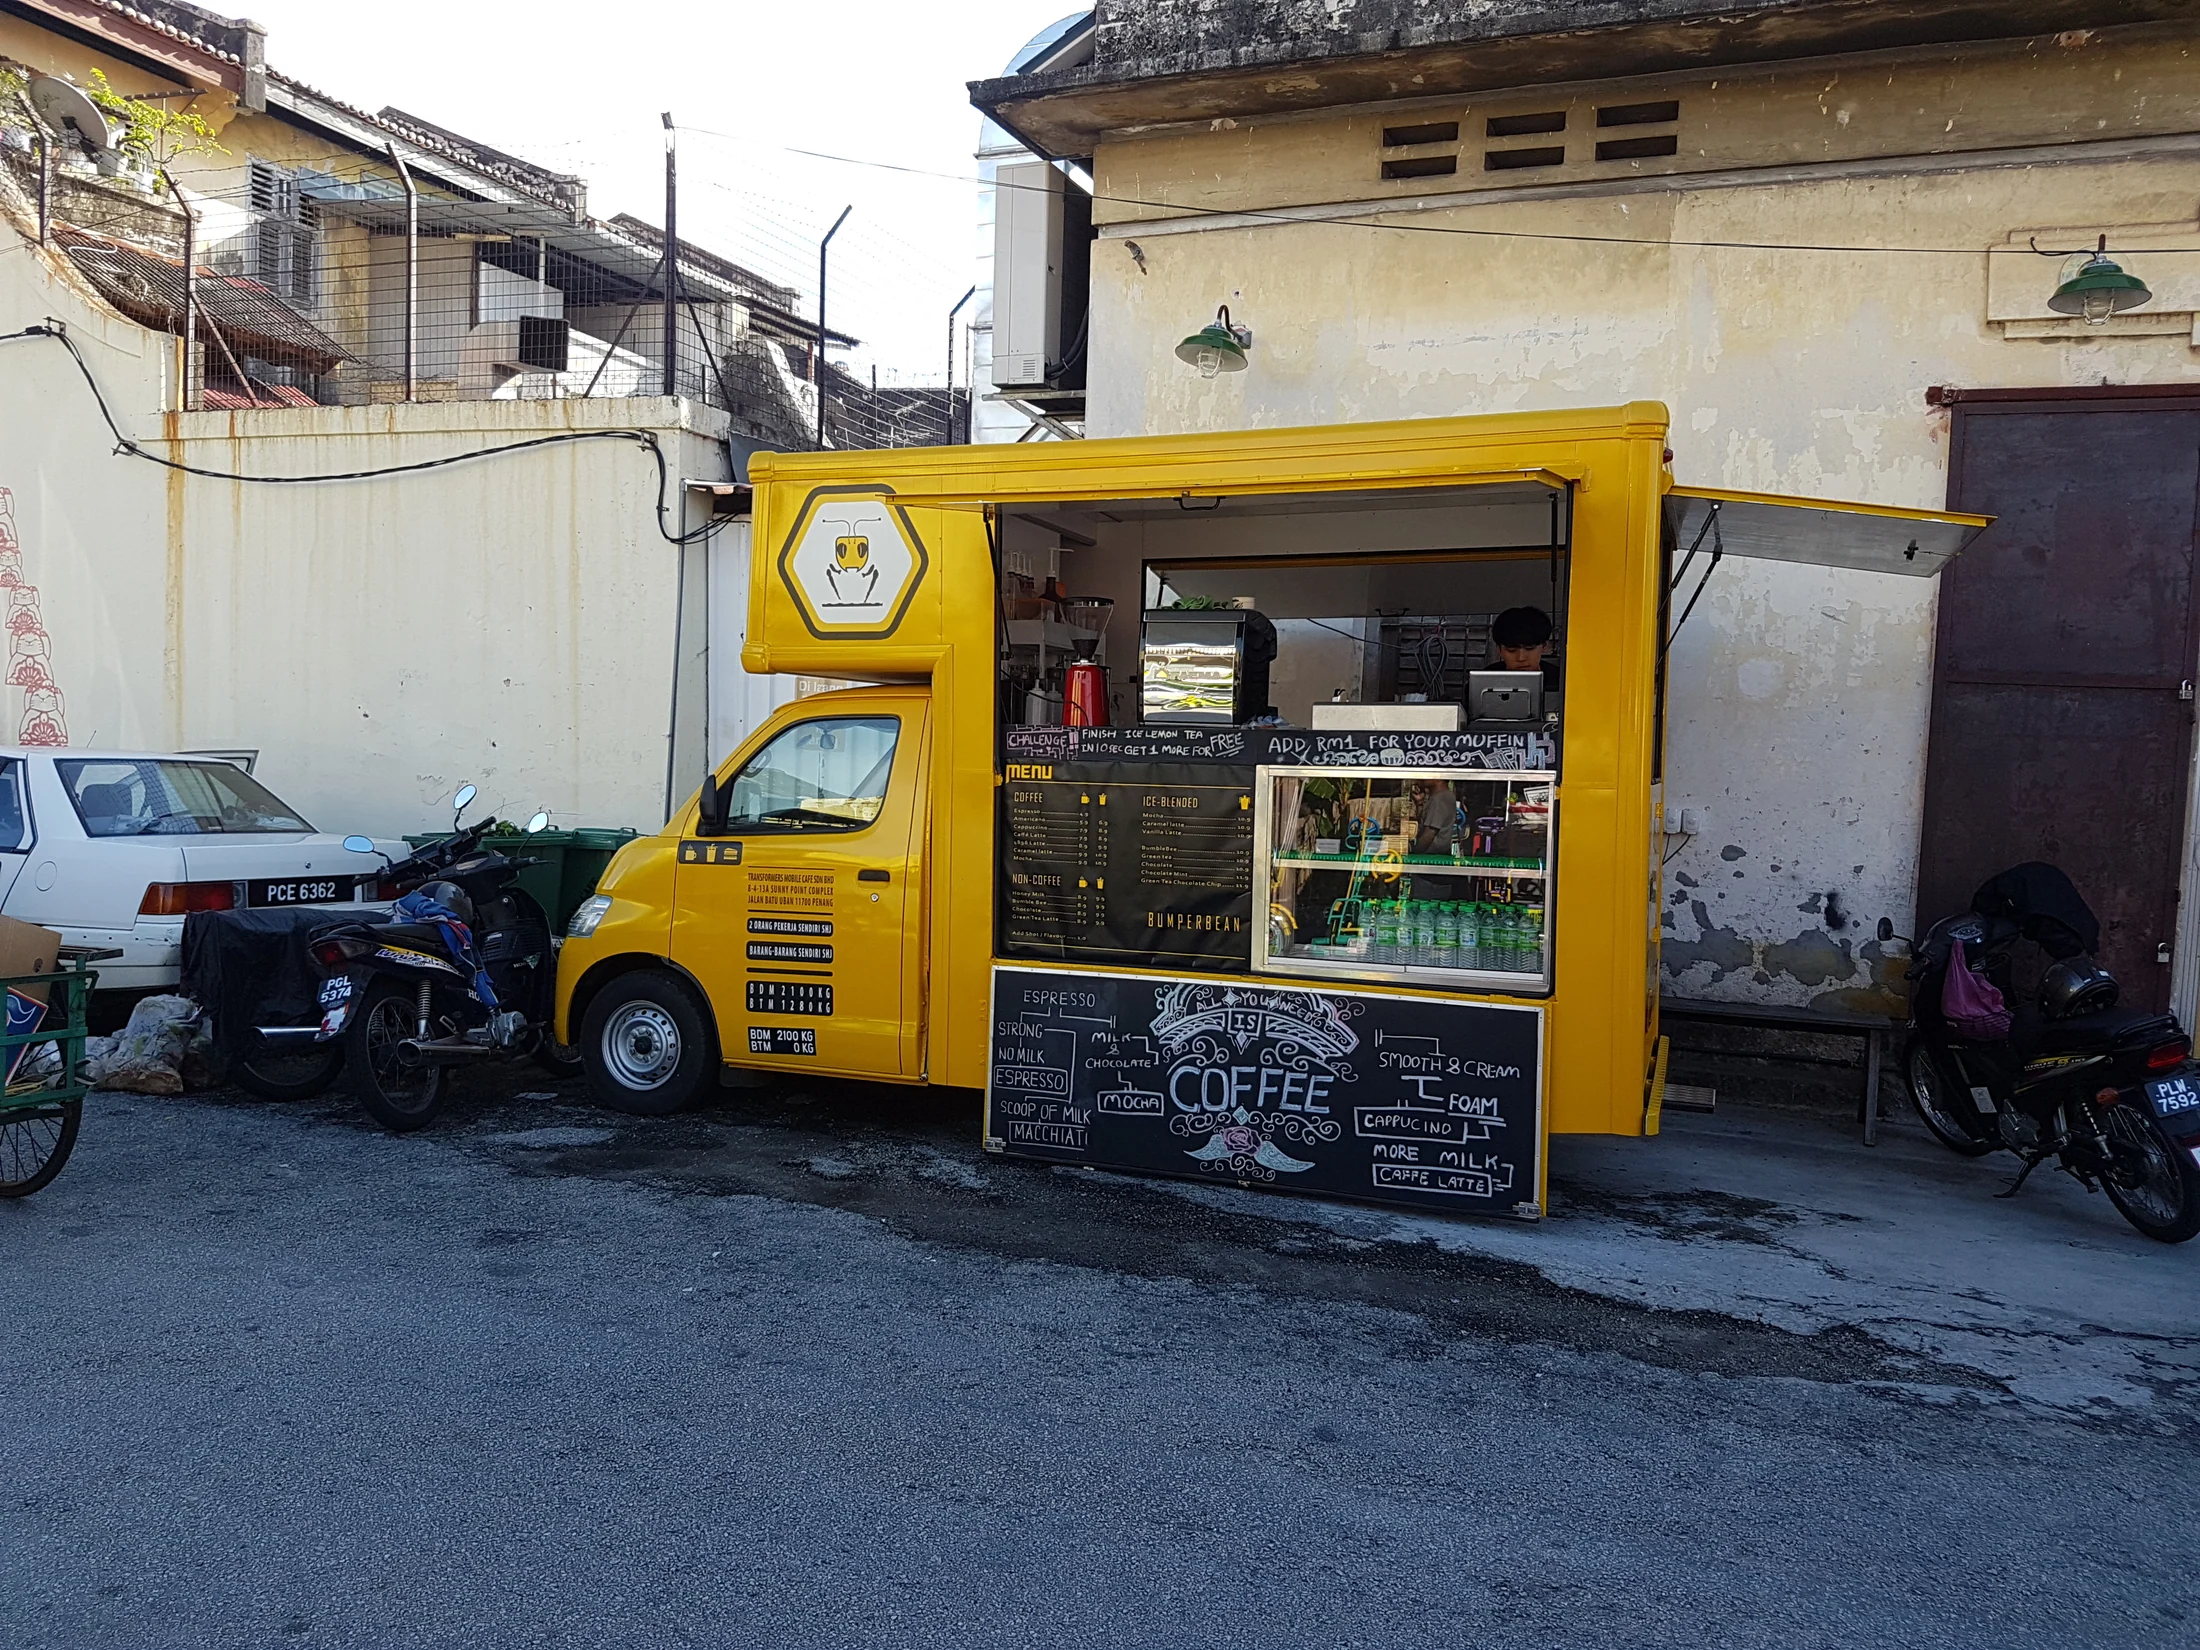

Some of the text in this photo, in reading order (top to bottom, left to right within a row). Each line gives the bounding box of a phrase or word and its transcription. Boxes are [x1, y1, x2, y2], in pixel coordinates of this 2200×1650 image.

[800, 680, 810, 691] Di
[1082, 728, 1116, 739] FINISH
[1146, 730, 1178, 738] LEMON
[1184, 730, 1203, 740] TEA
[1209, 732, 1244, 752] FREE
[1124, 745, 1146, 755] GET
[1149, 745, 1159, 755] 1
[1162, 745, 1189, 756] MORE
[1192, 746, 1213, 758] FOR
[1269, 734, 1524, 753] ADD RM1 FOR YOUR MUFFIN
[1006, 765, 1052, 783] MENU
[1014, 792, 1043, 803] COFFEE
[1143, 796, 1198, 808] ICE-BLENDED
[748, 873, 834, 884] TRANSFORMERS MOBILE CAFE SDN BHD
[1012, 874, 1061, 886] NON-COFFEE
[268, 882, 336, 902] PCE 6362
[771, 885, 789, 894] SUNNY
[791, 886, 807, 894] POINT
[809, 887, 833, 895] COMPLEX
[748, 895, 833, 907] JALAN BATU UBAN 11700 PENANG
[748, 921, 752, 929] 2
[754, 921, 772, 930] ORANG
[774, 922, 797, 932] PEKERJA
[798, 923, 820, 933] SENDIRI
[1148, 912, 1240, 932] BUMPERBEAN
[750, 945, 797, 957] BARANG-BARANG
[798, 947, 820, 958] SENDIRI
[326, 976, 351, 990] PGL
[320, 986, 352, 1003] 5374
[1024, 990, 1096, 1007] ESPRESSO
[1196, 990, 1314, 1024] ALL YOU NEED
[1234, 1014, 1256, 1029] IS
[750, 1029, 813, 1041] BDM 2100 KG
[998, 1022, 1043, 1038] STRONG
[1092, 1032, 1131, 1043] MILK
[751, 1041, 814, 1053] BTM 0 KG
[998, 1047, 1045, 1064] NO MILK
[1085, 1057, 1151, 1068] CHOCOLATE
[1379, 1052, 1441, 1071] SMOOTH
[1464, 1060, 1520, 1078] CREAM
[995, 1068, 1064, 1090] ESPRESSO
[1169, 1066, 1335, 1114] COFFEE
[2158, 1079, 2187, 1098] PLW
[1104, 1094, 1159, 1109] MOCHA
[1449, 1093, 1498, 1116] FOAM
[2158, 1092, 2200, 1112] 7592
[1000, 1101, 1091, 1125] SCOOP OF MILK
[1364, 1115, 1451, 1134] CAPPUCINO
[1373, 1144, 1498, 1170] MORE MILK
[1380, 1168, 1485, 1192] CAFFE LATTE
